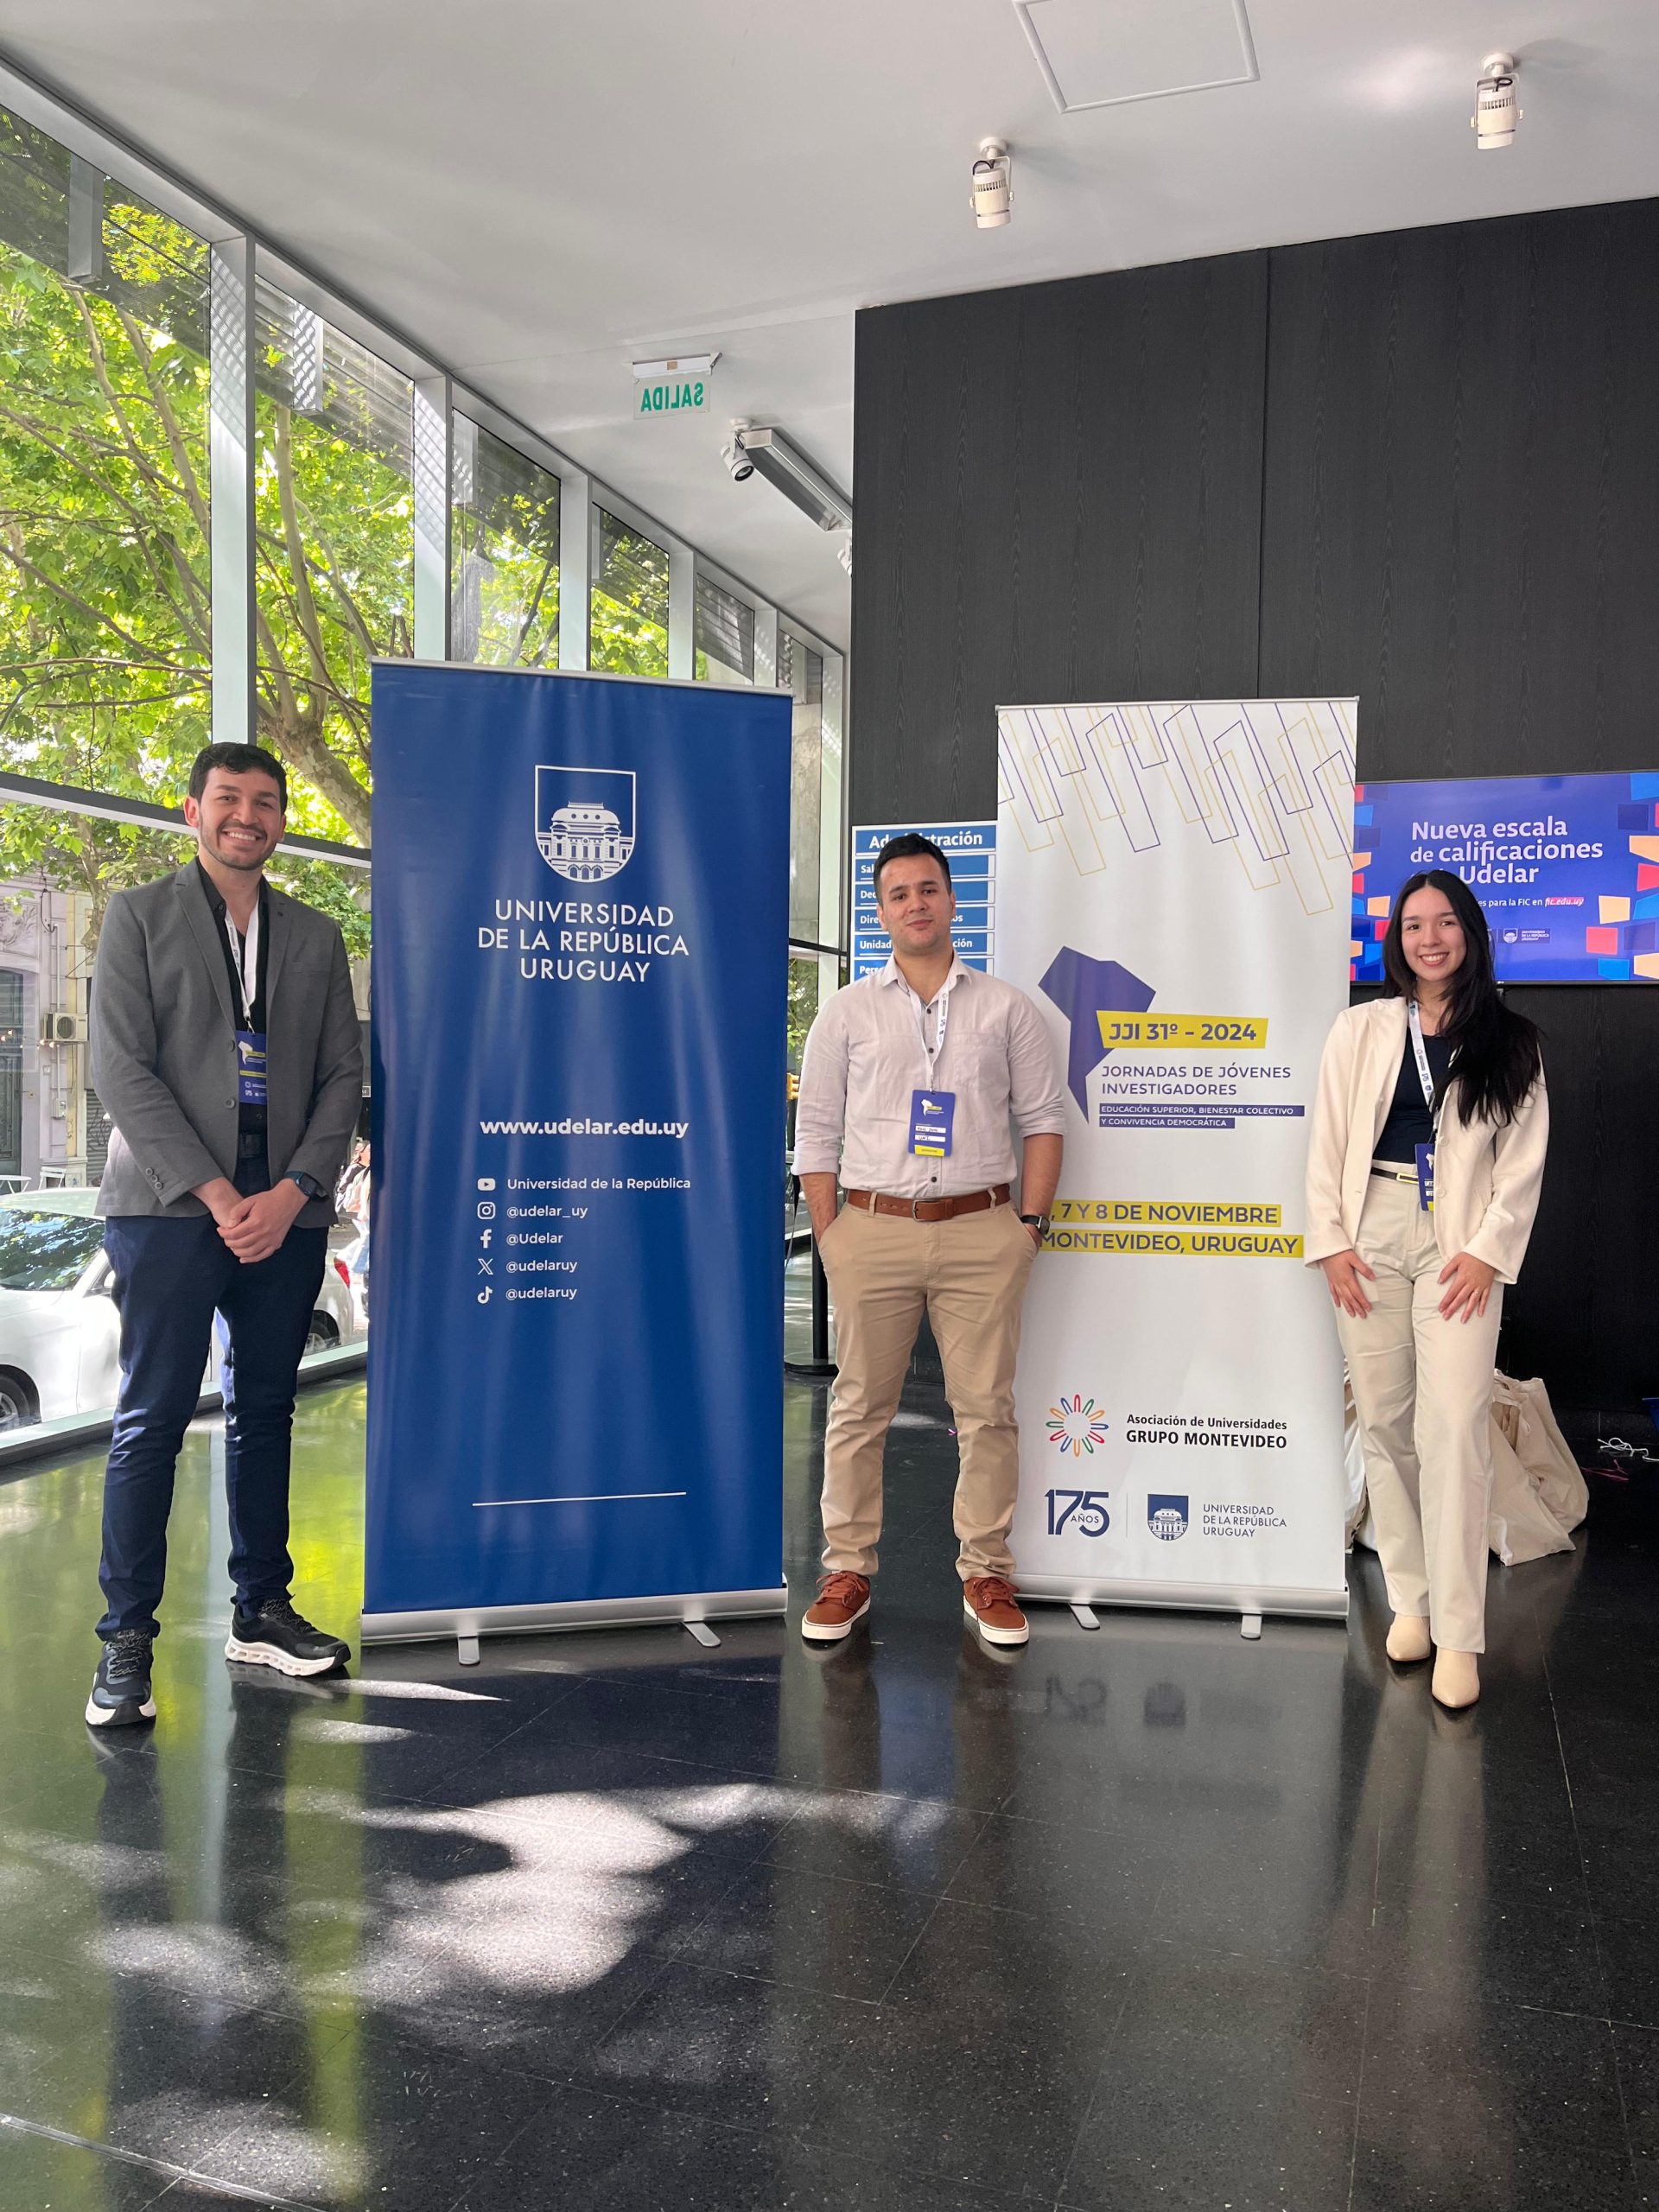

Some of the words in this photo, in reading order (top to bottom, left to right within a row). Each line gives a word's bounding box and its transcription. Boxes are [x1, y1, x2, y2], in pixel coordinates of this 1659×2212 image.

[1412, 822, 1487, 840] Nueva
[1492, 816, 1567, 837] escala
[868, 830, 982, 849] Adtración
[1410, 847, 1433, 862] de
[1439, 838, 1603, 866] calificaciones
[1459, 862, 1540, 884] Udelar
[1489, 899, 1507, 908] para
[1545, 897, 1584, 907] fic.edu.uy
[495, 899, 674, 927] UNIVERSIDAD
[478, 927, 509, 950] DE
[519, 929, 550, 950] LA
[560, 926, 690, 956] REPÚBLICA
[860, 939, 892, 949] Unidad
[952, 938, 972, 947] ción
[520, 957, 650, 982] URUGUAY
[1109, 1023, 1140, 1040] JJI
[1201, 1023, 1256, 1040] 2024
[1102, 1065, 1187, 1077] JORNADAS
[1192, 1066, 1213, 1077] DE
[1218, 1062, 1291, 1078] JÓVENES
[1102, 1084, 1237, 1096] INVESTIGADORES
[1101, 1104, 1150, 1113] EDUCACIÓN
[1152, 1106, 1197, 1115] SUPERIOR,
[1198, 1106, 1244, 1115] BIENESTAR
[480, 1118, 689, 1138] www.udelar.edu.uy
[1167, 1117, 1227, 1127] DEMOCRÁTICA
[507, 1178, 587, 1190] Universidad
[591, 1178, 608, 1189] de
[612, 1178, 623, 1189] la
[626, 1177, 691, 1192] República
[506, 1205, 588, 1218] @udelar_uy
[1061, 1203, 1071, 1218] 7
[1077, 1203, 1090, 1219] Y
[1096, 1204, 1109, 1220] 8
[1114, 1204, 1142, 1221] DE
[1147, 1205, 1278, 1224] NOVIEMBRE
[505, 1233, 563, 1246] @Udelar
[1192, 1235, 1299, 1255] URUGUAY
[505, 1260, 577, 1273] @udelaruy
[505, 1287, 577, 1300] @udelaruy
[1127, 1414, 1187, 1427] Asociación
[1190, 1416, 1204, 1427] de
[1207, 1417, 1287, 1430] Universidades
[1126, 1430, 1179, 1445] GRUPO
[1184, 1433, 1287, 1449] MONTEVIDEO
[1044, 1489, 1110, 1537] 175
[1203, 1503, 1274, 1515] UNIVERSIDAD
[1071, 1513, 1099, 1523] AÑOS
[1203, 1515, 1216, 1525] DE
[1218, 1516, 1231, 1525] LA
[1233, 1515, 1287, 1527] REPÚBLICA
[1203, 1527, 1255, 1537] URUGUAY
